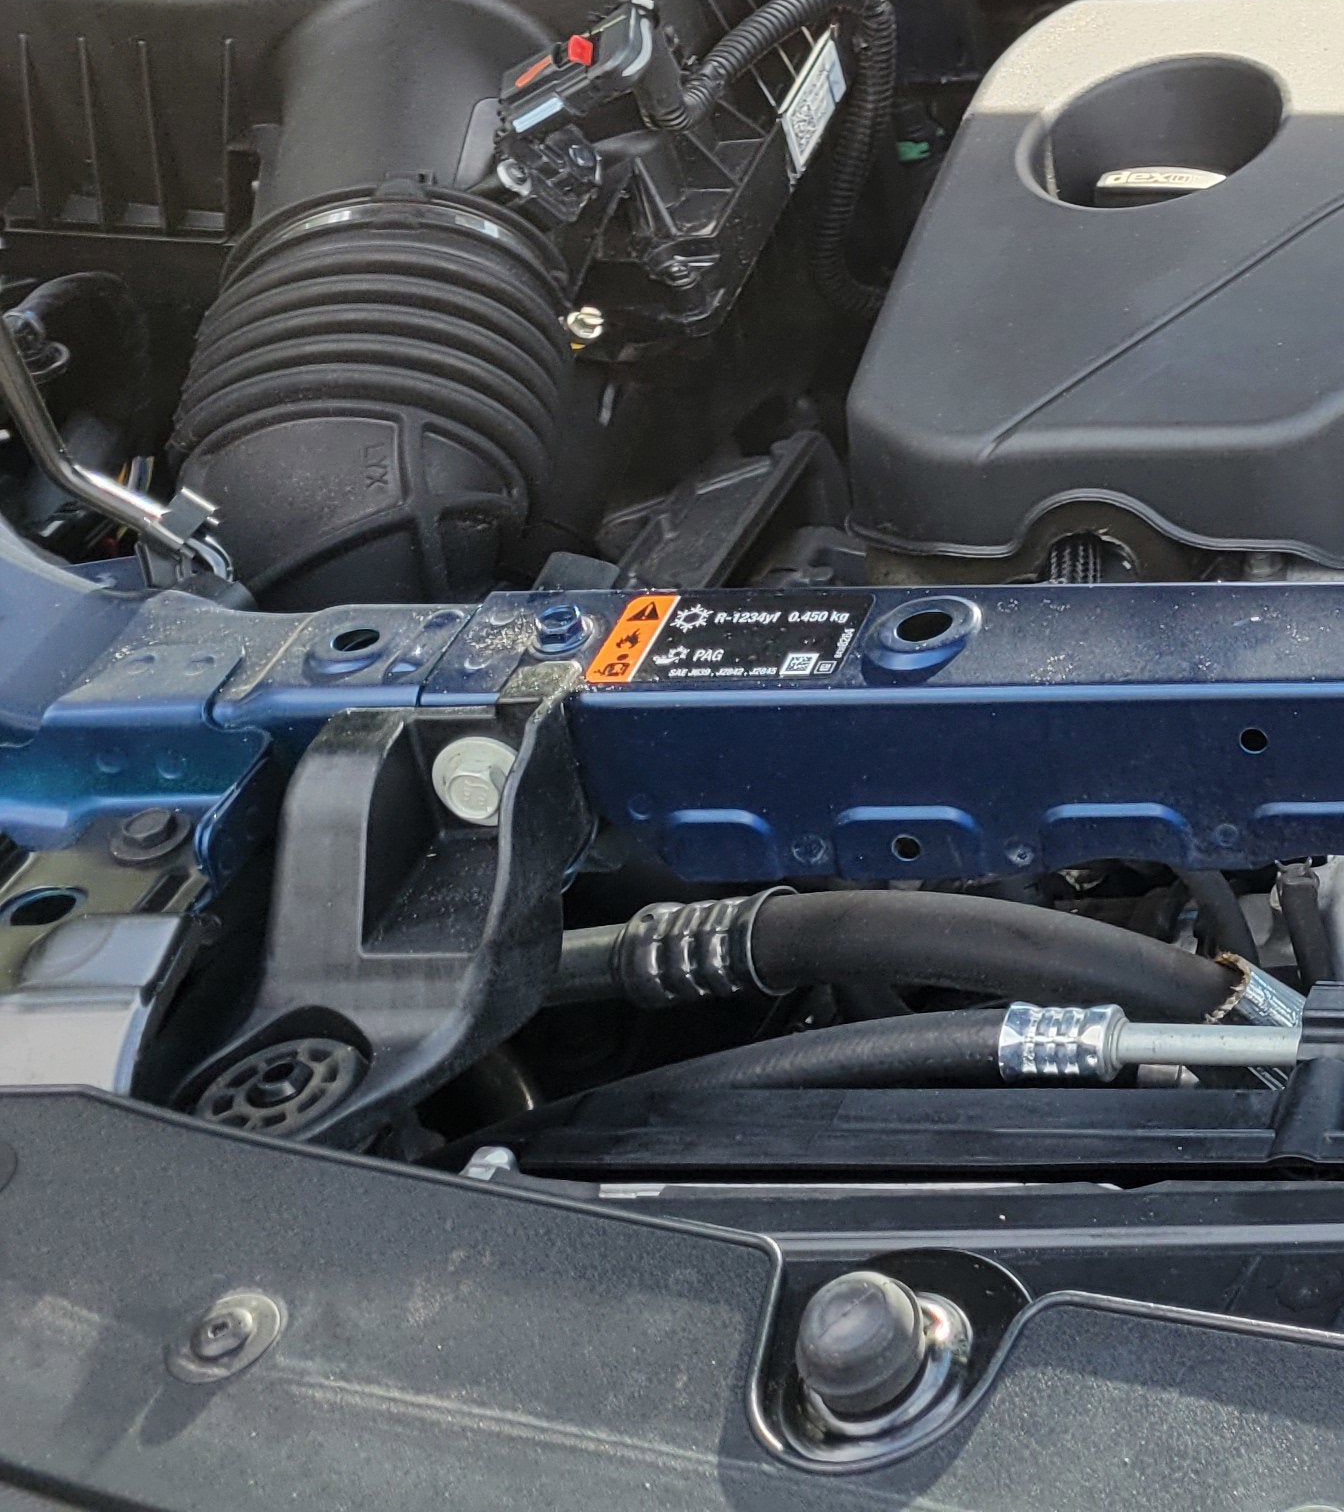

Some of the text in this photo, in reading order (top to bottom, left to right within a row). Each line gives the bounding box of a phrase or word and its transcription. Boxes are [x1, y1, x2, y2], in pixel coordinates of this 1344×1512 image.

[714, 610, 850, 625] R-1234yf 0.450 kg
[692, 649, 725, 662] PAG
[668, 668, 688, 677] SAE
